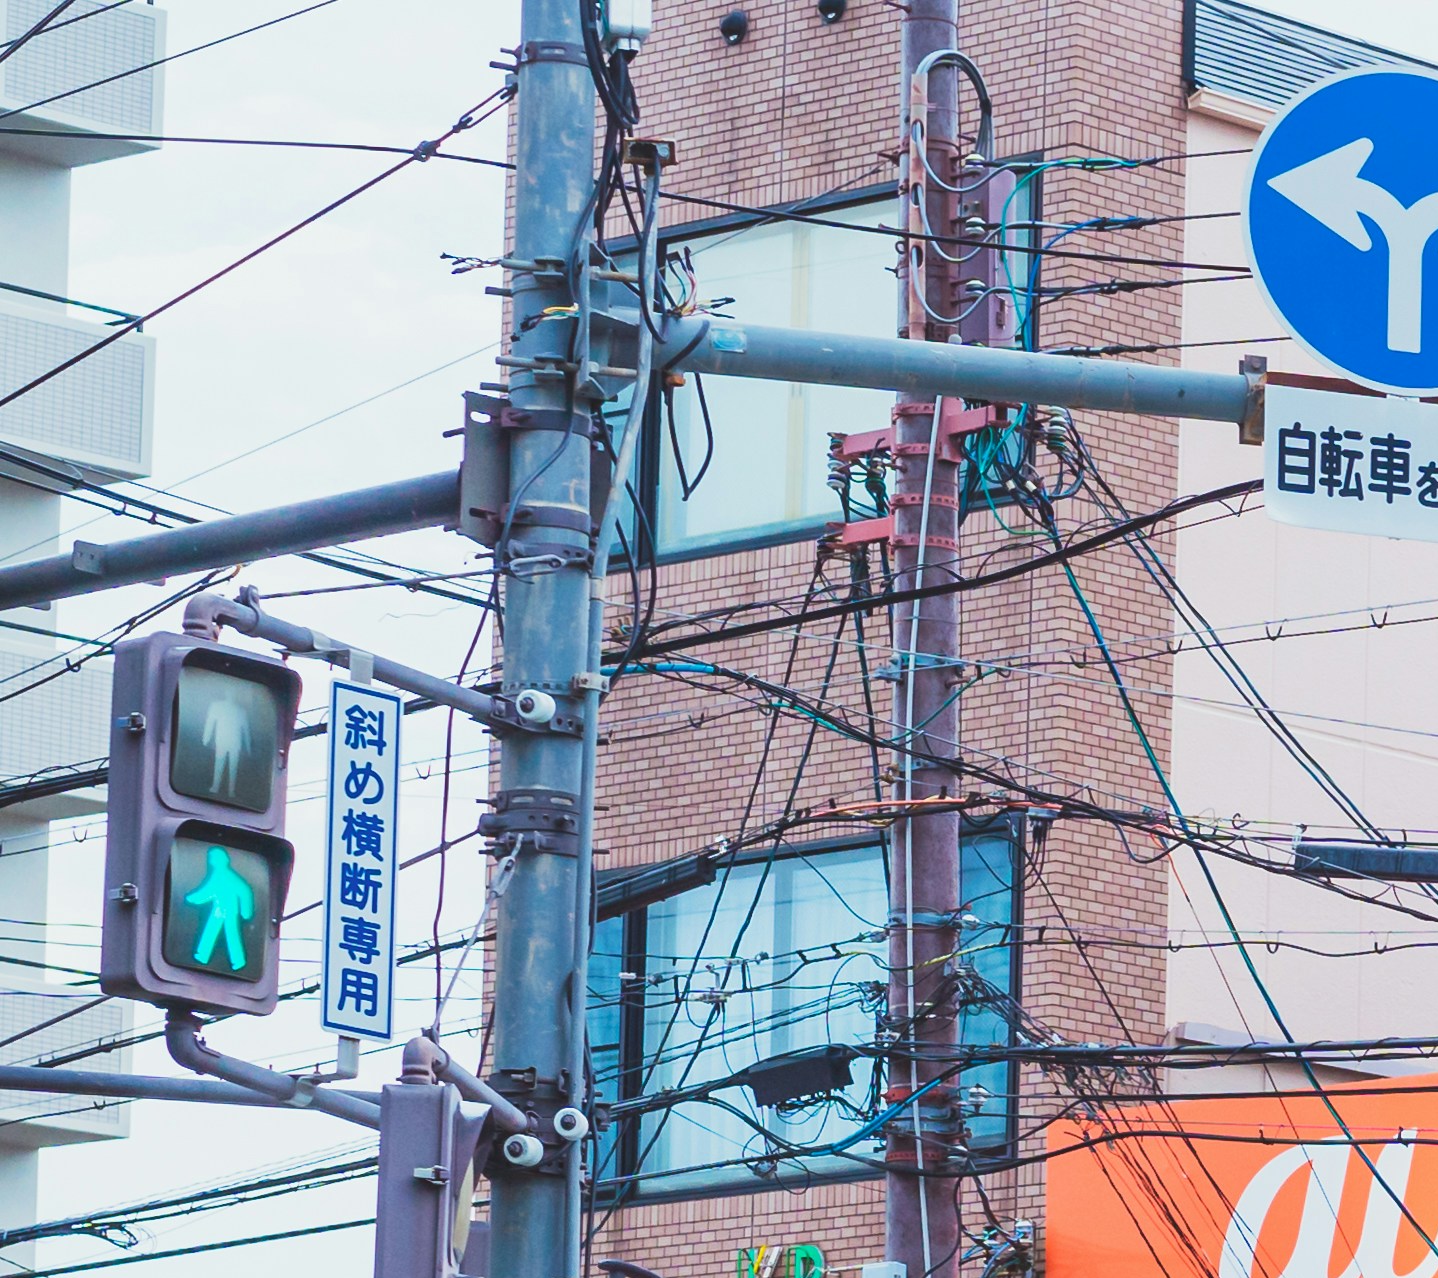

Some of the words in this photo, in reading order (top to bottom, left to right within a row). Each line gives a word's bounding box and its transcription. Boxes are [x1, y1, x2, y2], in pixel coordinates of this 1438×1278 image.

[336, 704, 387, 1018] 斜め横断専用
